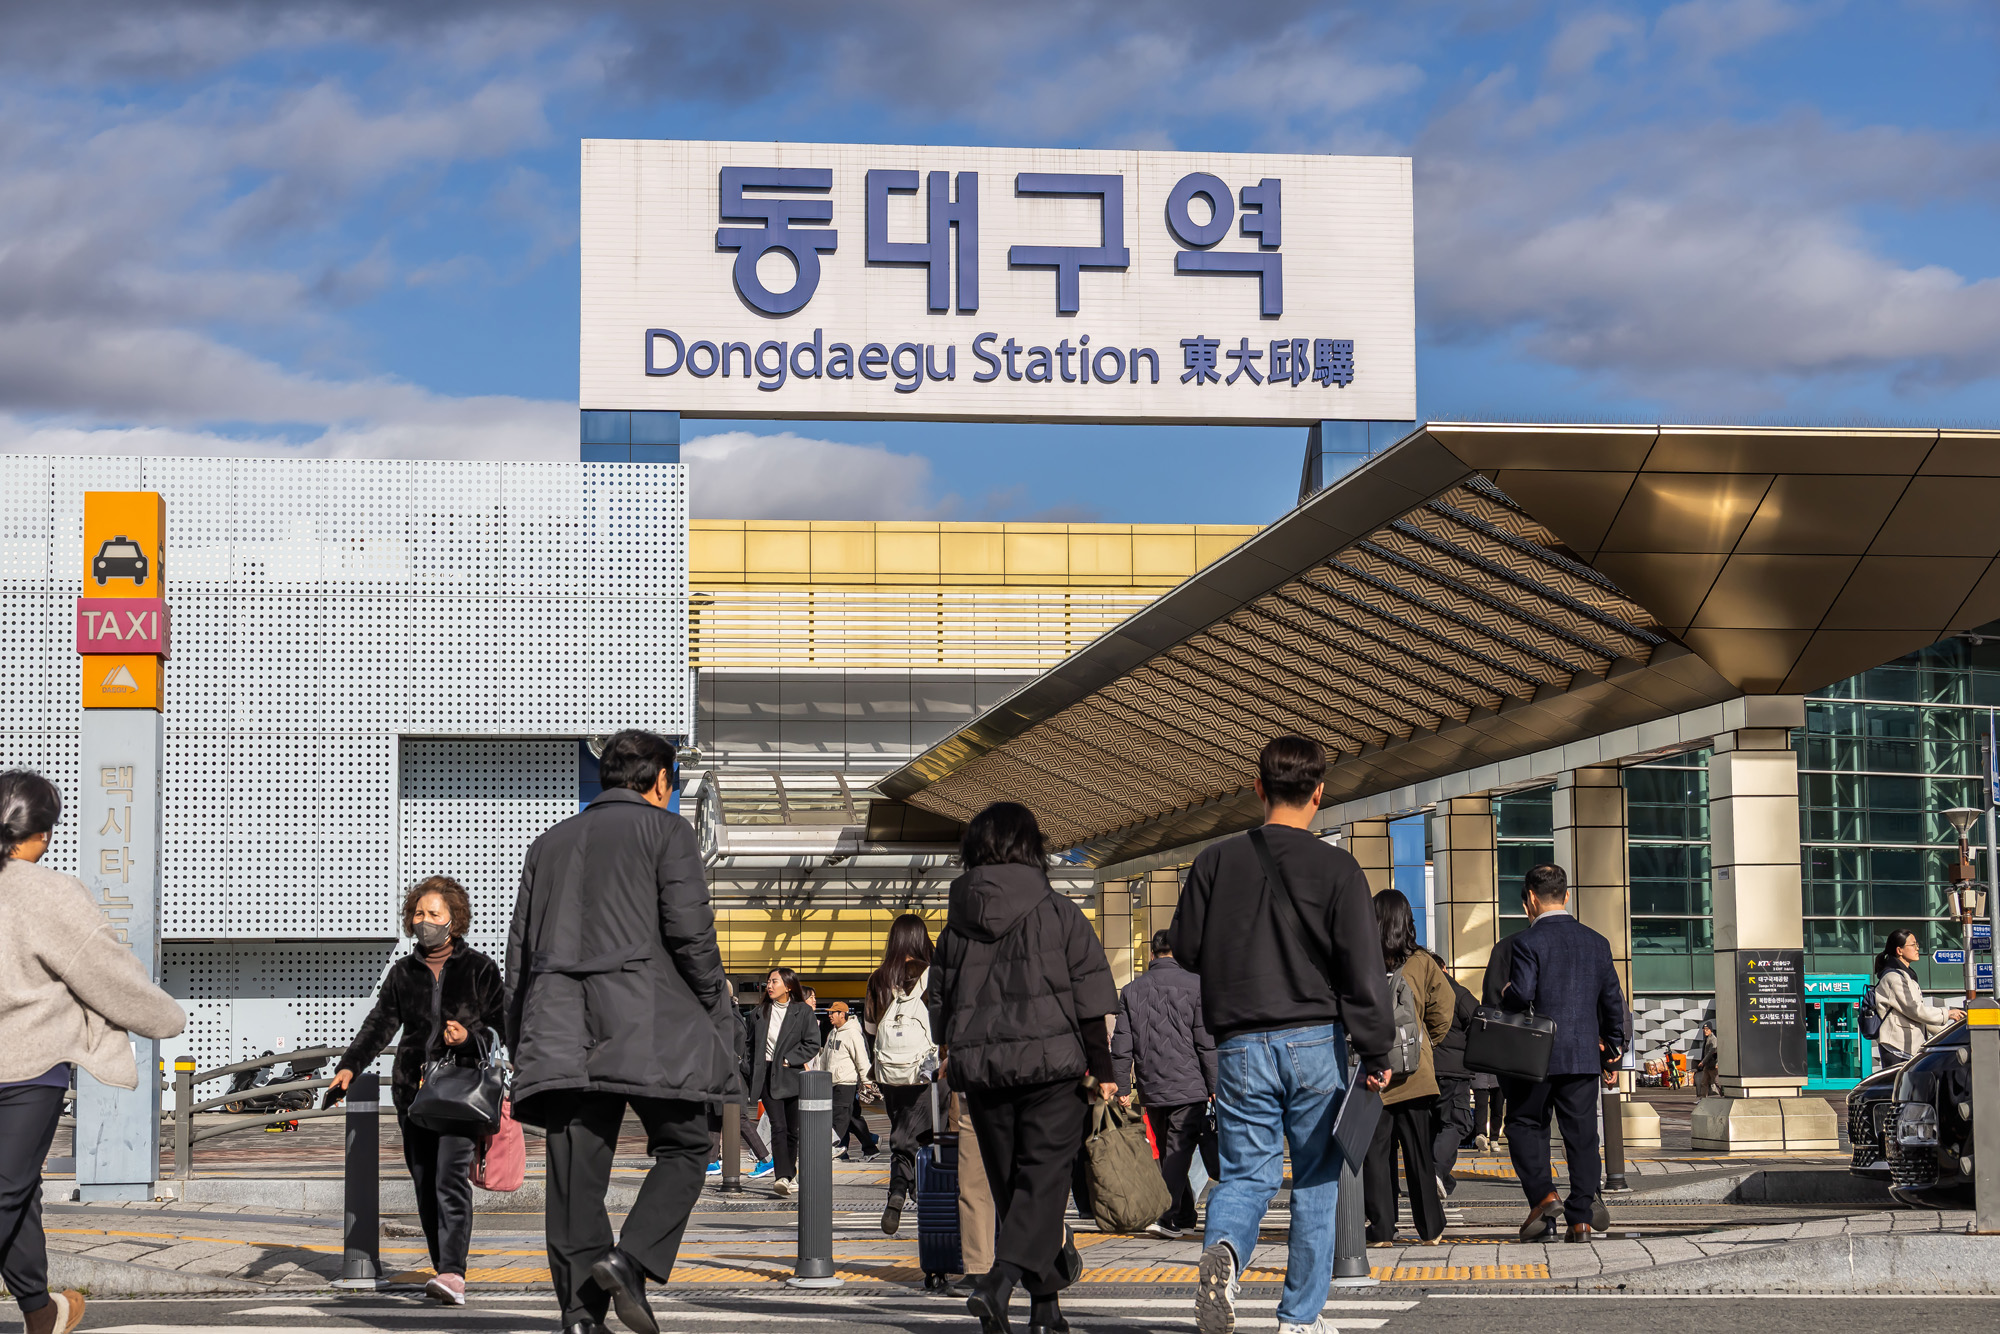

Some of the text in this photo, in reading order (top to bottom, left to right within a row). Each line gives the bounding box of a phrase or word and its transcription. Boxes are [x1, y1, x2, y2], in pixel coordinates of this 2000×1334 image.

[716, 167, 1283, 319] 동대구역
[645, 328, 1355, 394] Dongdaegu Station 東大邱驛
[81, 610, 157, 640] TAXI
